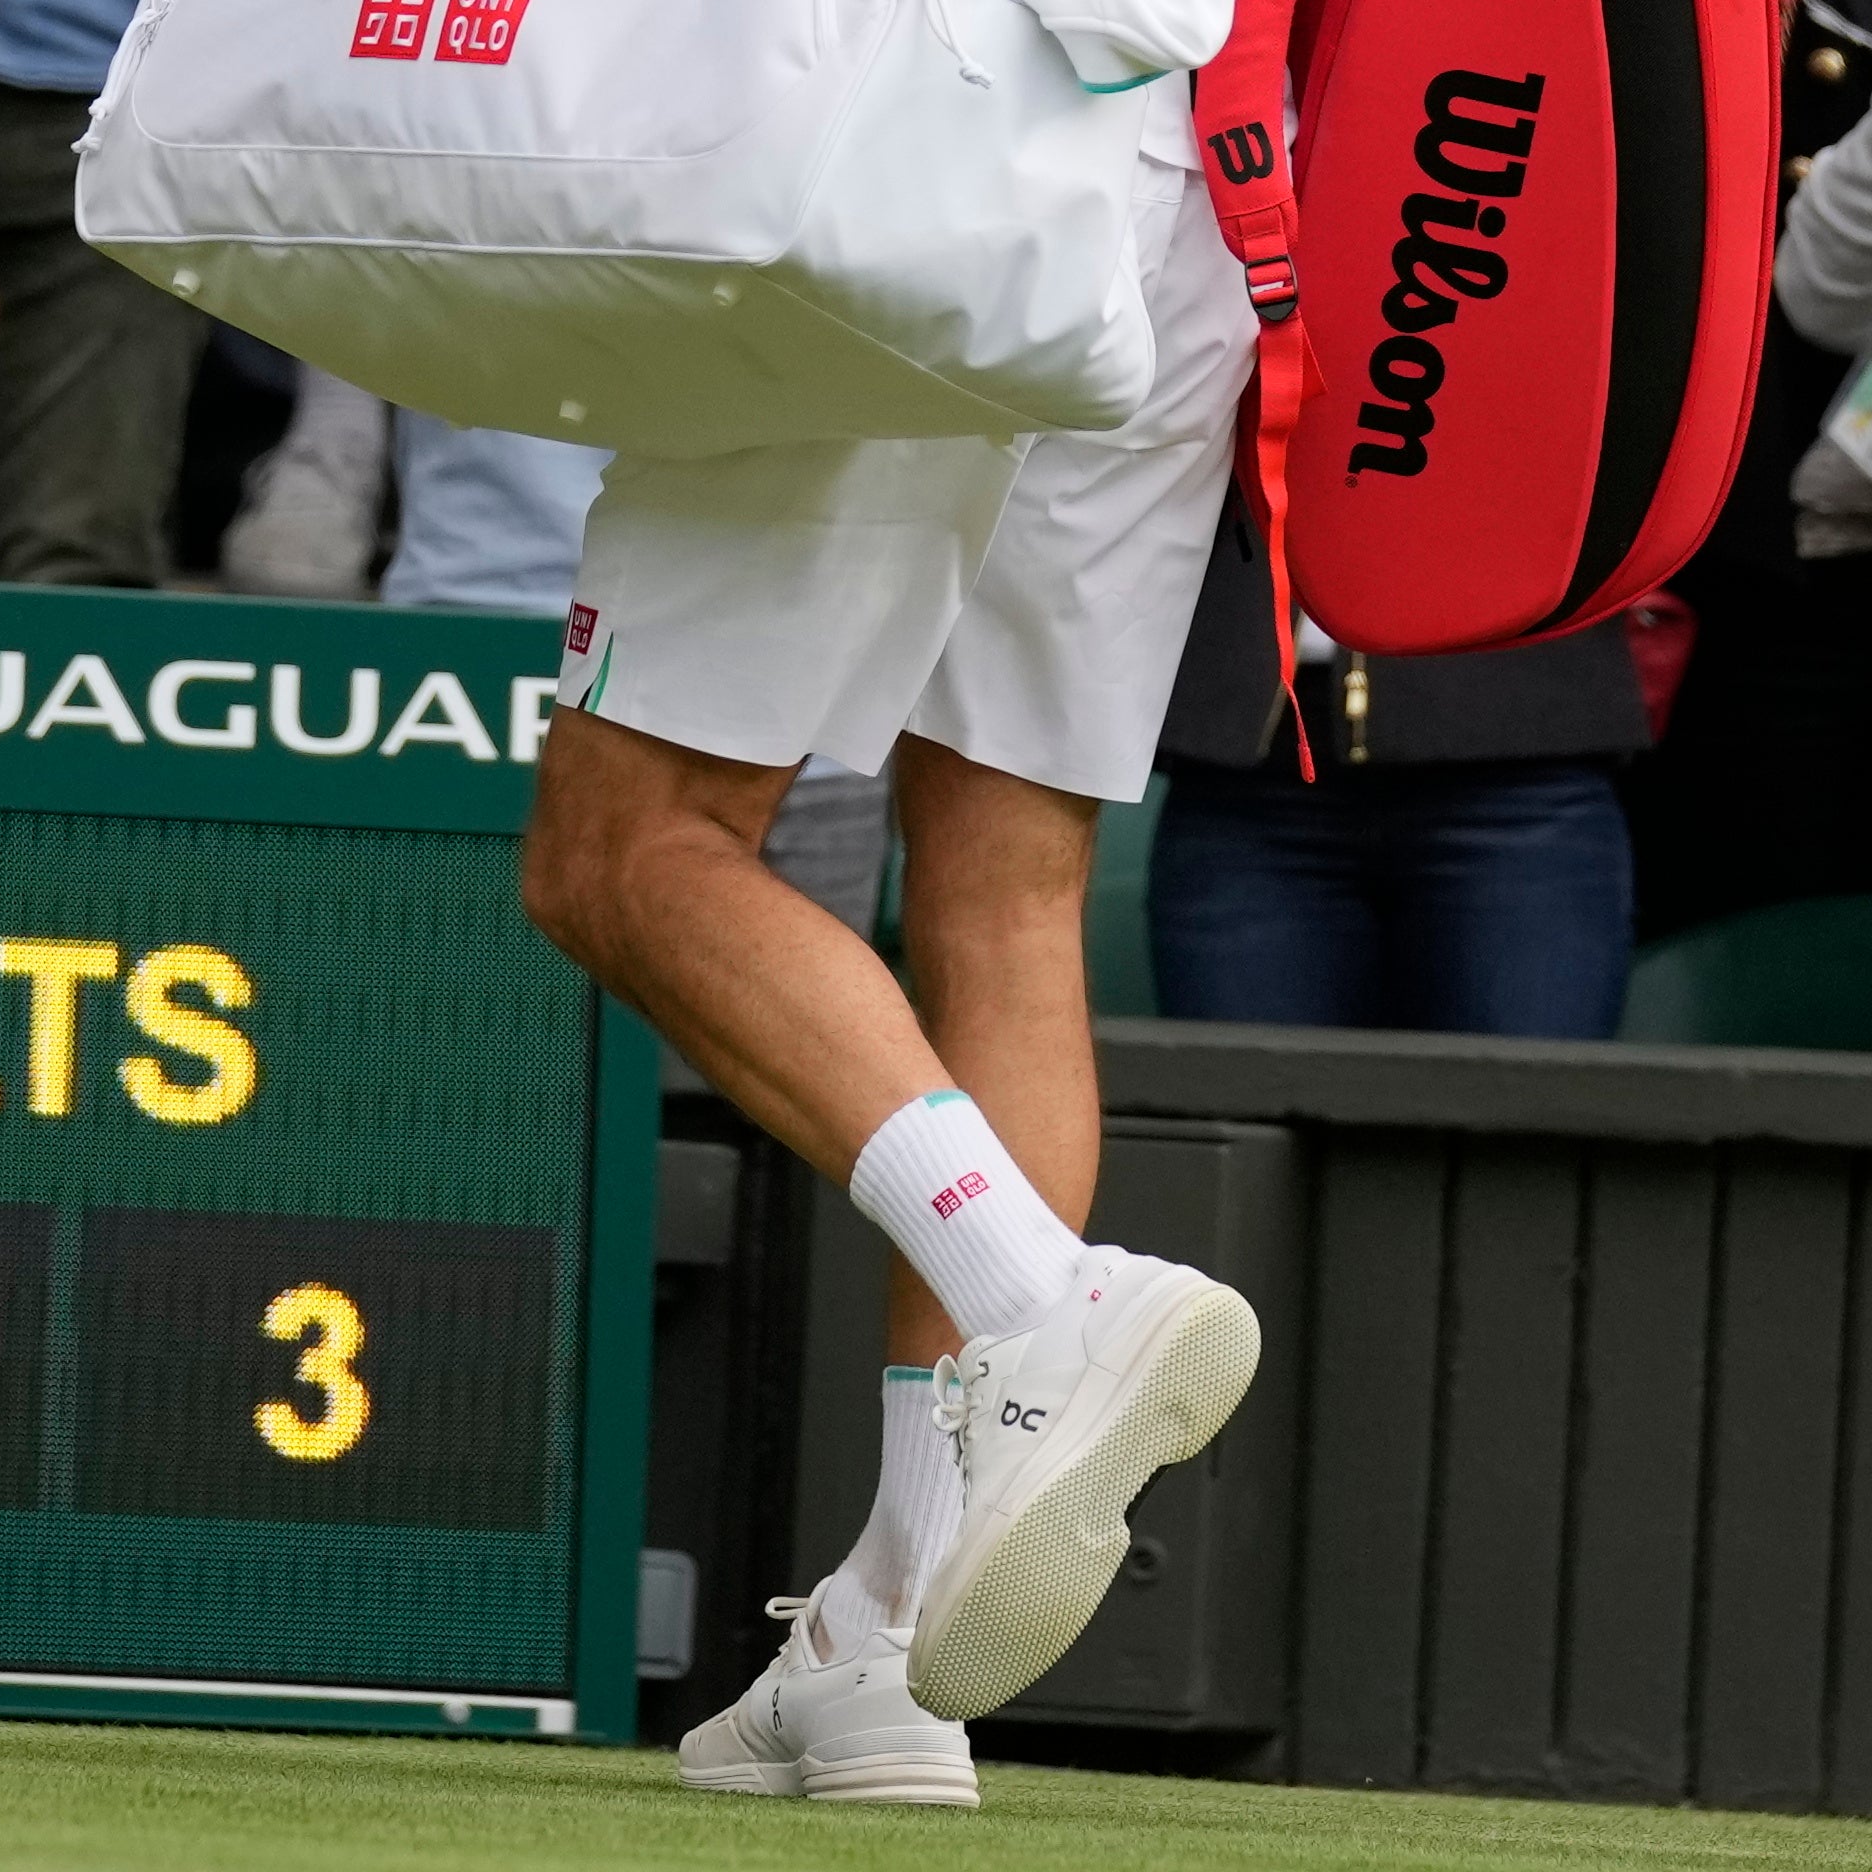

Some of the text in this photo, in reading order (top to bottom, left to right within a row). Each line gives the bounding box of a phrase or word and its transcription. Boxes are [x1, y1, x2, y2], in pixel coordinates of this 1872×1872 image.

[448, 15, 510, 55] QLO
[1347, 69, 1545, 477] Wilson
[574, 610, 592, 630] UNI
[252, 1281, 371, 1462] 3
